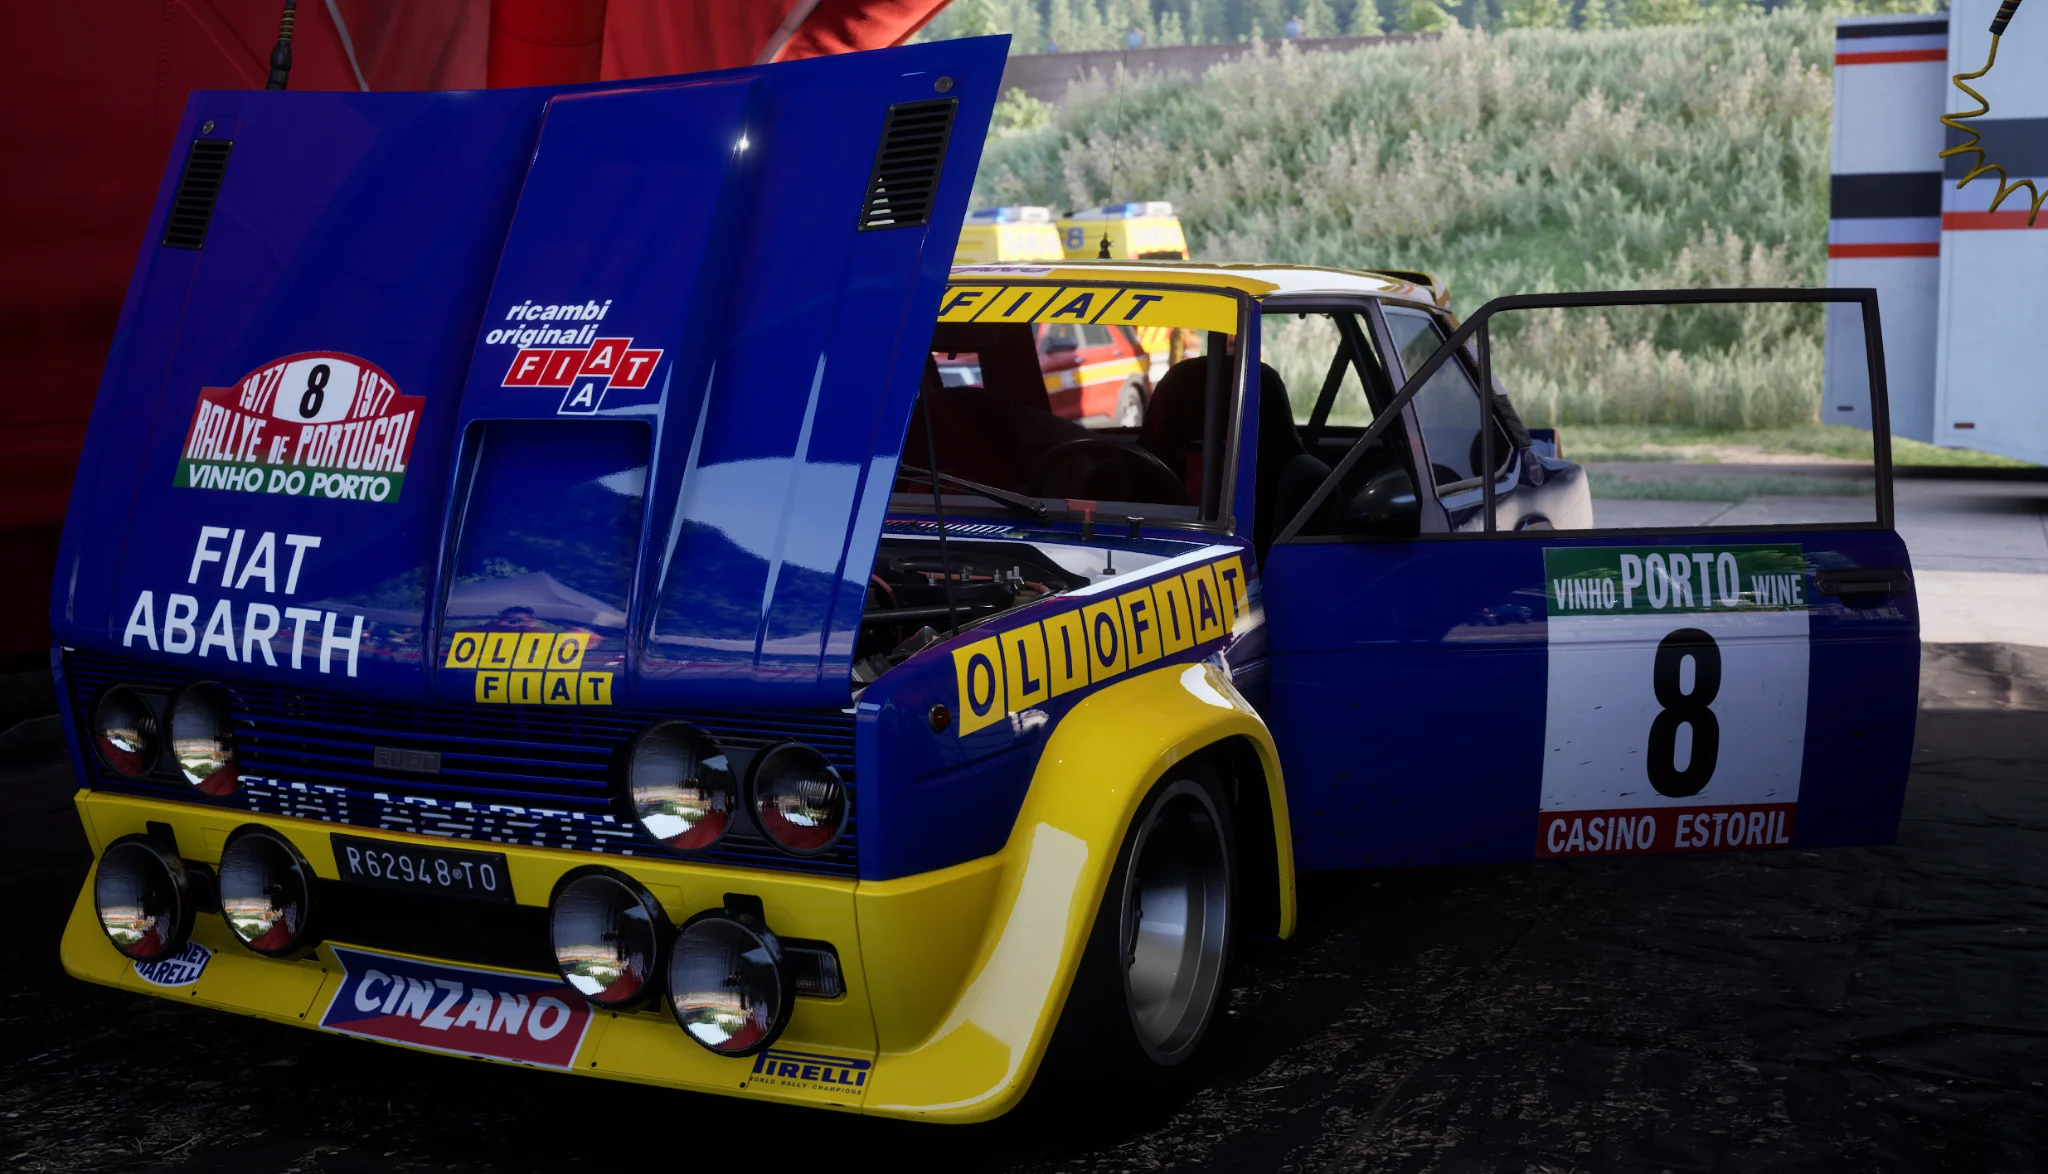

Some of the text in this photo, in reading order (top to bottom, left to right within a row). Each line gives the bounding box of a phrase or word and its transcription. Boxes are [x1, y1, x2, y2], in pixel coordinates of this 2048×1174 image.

[505, 299, 612, 321] ricambi
[485, 324, 599, 349] originali
[515, 346, 649, 381] FIAT
[239, 362, 287, 413] 1977
[298, 364, 331, 418] 8
[352, 369, 396, 419] 1977
[186, 399, 416, 473] RALLYE DE PORTUGAL
[189, 464, 391, 502] VINHO DO PORTO
[188, 526, 322, 595] FIAT
[1553, 552, 1804, 611] VINHO PORTO WINE
[123, 590, 365, 677] ABARTH
[455, 637, 580, 665] OLIO
[483, 676, 604, 701] FIAT
[1646, 627, 1722, 799] 8
[1547, 811, 1790, 854] CASINO ESTORIL
[354, 969, 572, 1041] CINZANO
[753, 1048, 872, 1087] PIRELLI
[780, 1081, 807, 1089] RALLY
[812, 1084, 863, 1095] CHAMPIONS
